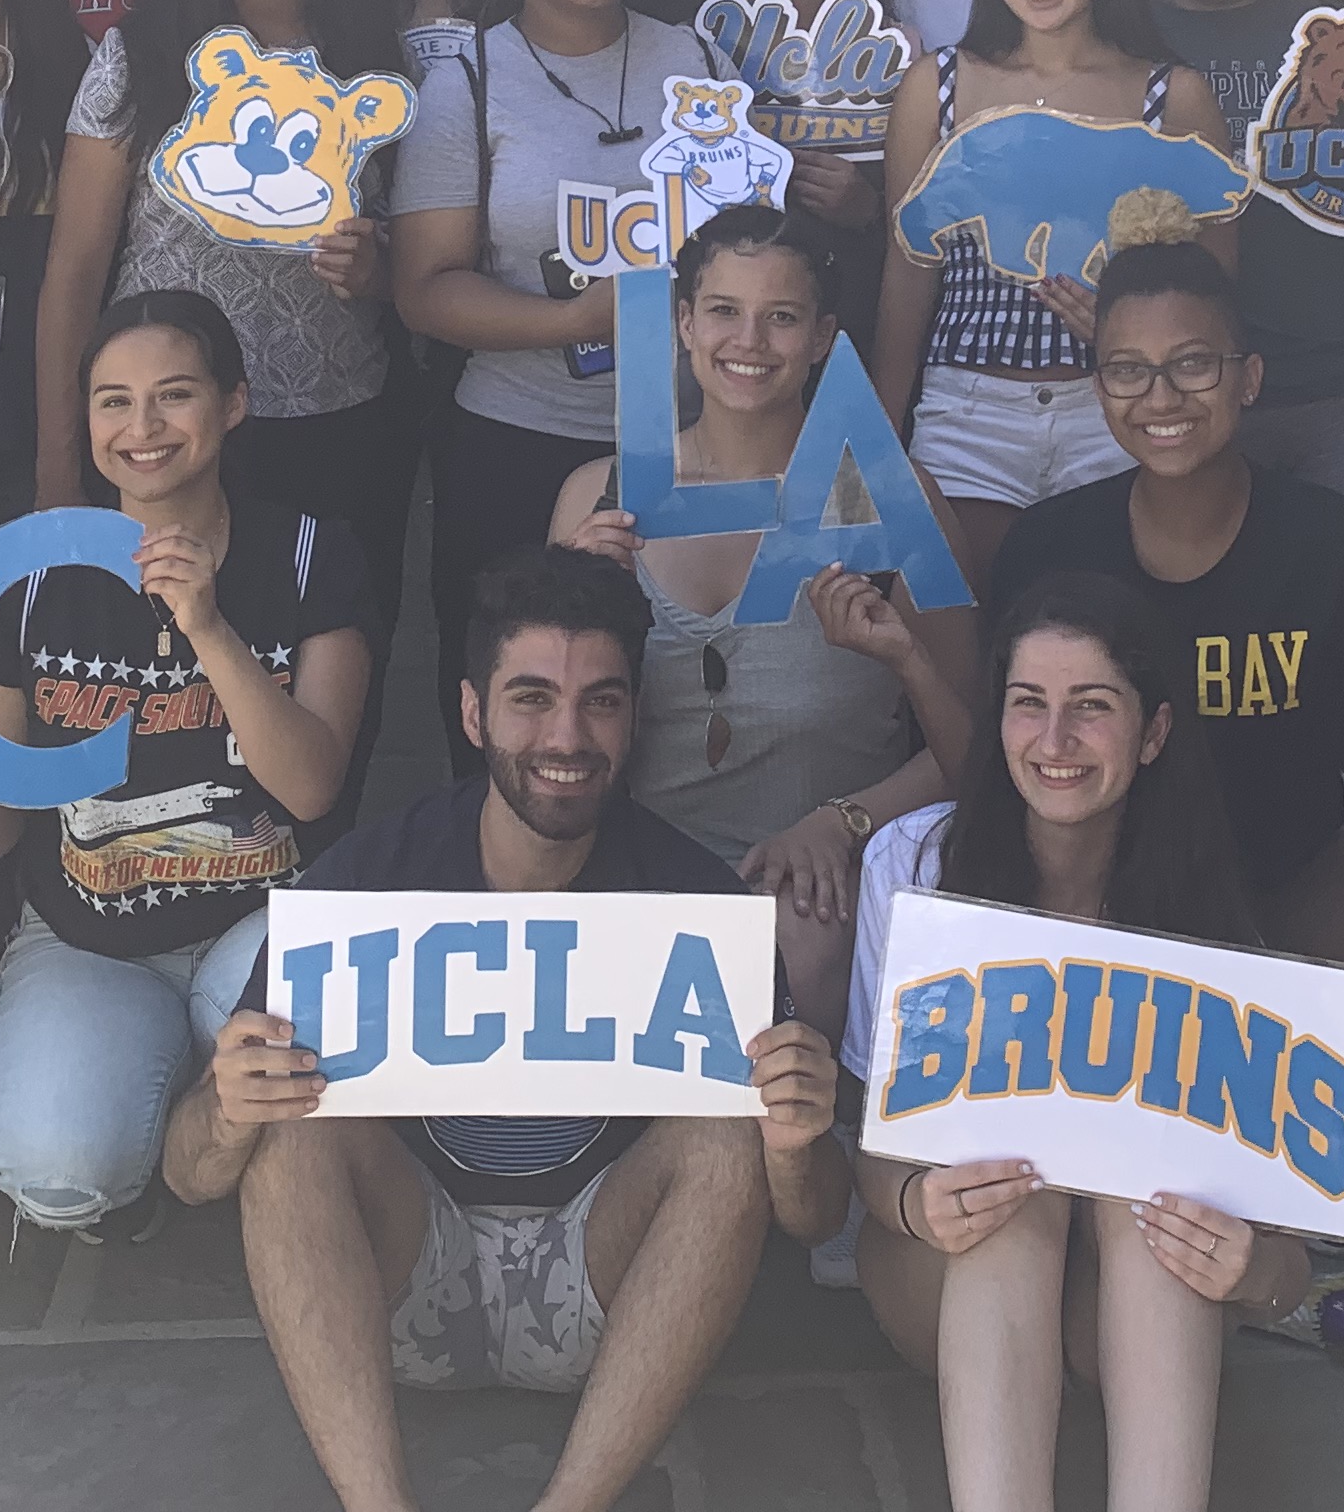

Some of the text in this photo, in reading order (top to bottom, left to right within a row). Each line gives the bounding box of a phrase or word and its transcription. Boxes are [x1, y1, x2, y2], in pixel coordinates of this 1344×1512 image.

[688, 144, 743, 165] BRUINS
[755, 114, 889, 144] RUINS
[566, 172, 689, 268] UCL
[1195, 630, 1309, 718] BAY
[34, 677, 140, 731] SPACE
[103, 855, 147, 890] FOR
[149, 854, 204, 879] NEW
[282, 919, 754, 1088] UCLA
